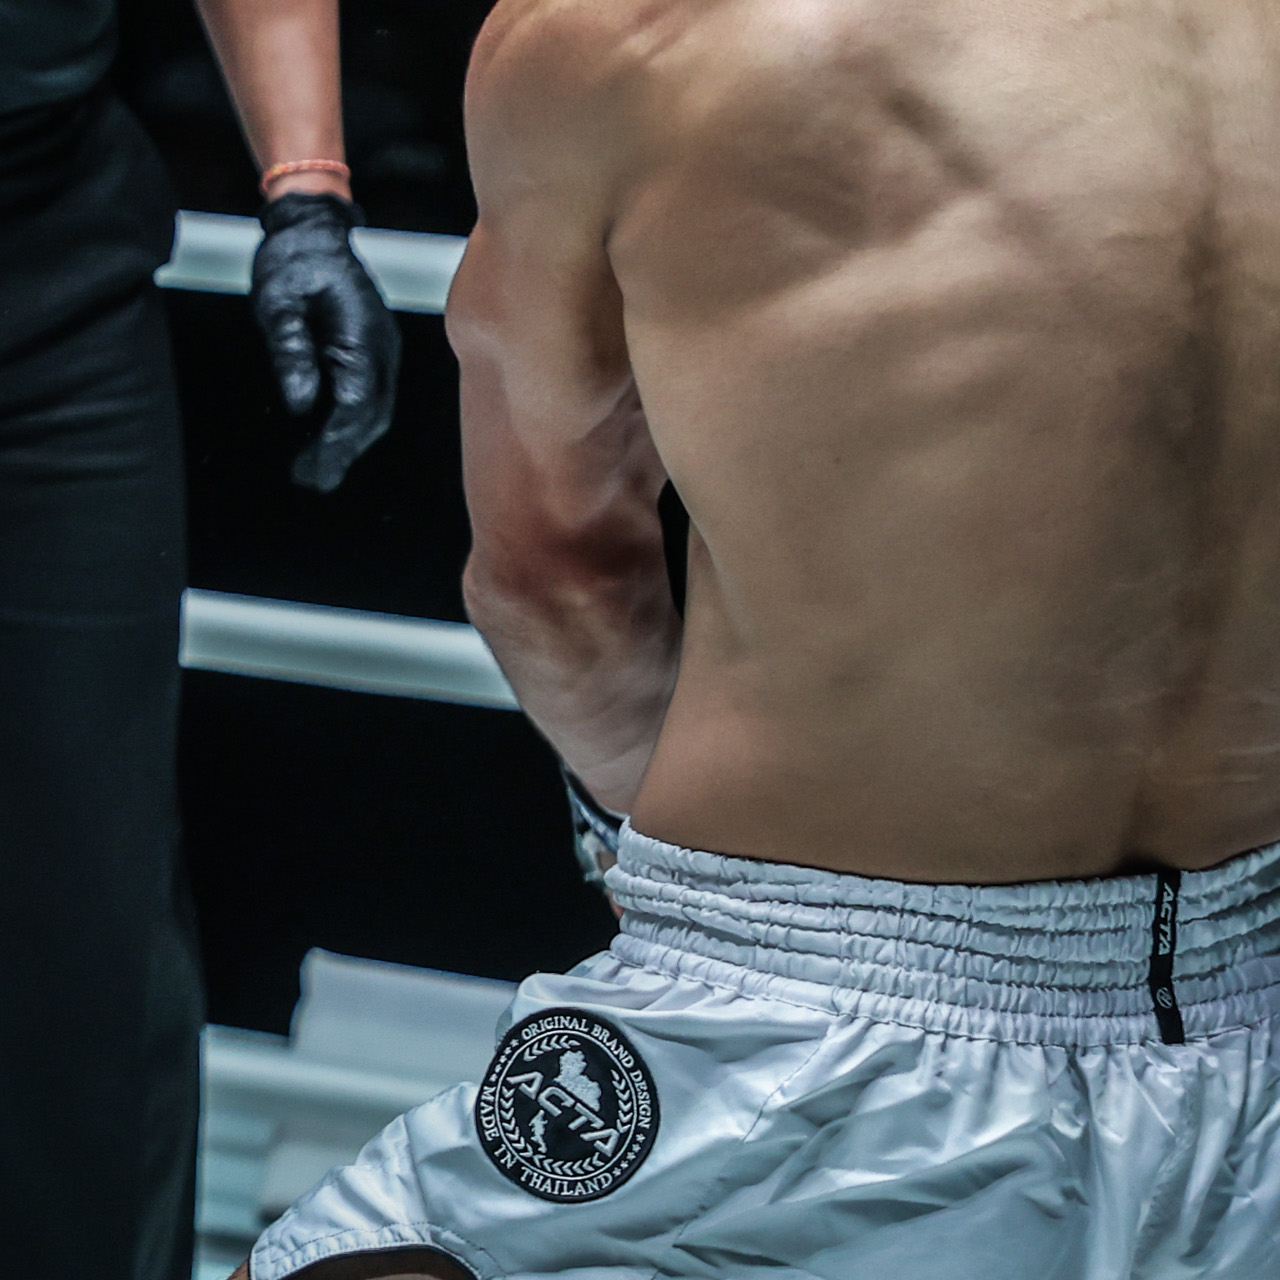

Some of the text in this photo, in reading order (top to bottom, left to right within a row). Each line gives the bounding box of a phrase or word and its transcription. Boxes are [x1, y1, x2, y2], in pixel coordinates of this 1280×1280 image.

[1158, 882, 1174, 956] ACTA
[506, 1071, 621, 1157] ACTA
[521, 1016, 652, 1130] ORIGINAL BRAND DESIGN
[480, 1086, 614, 1196] MADE IN THAILAND
